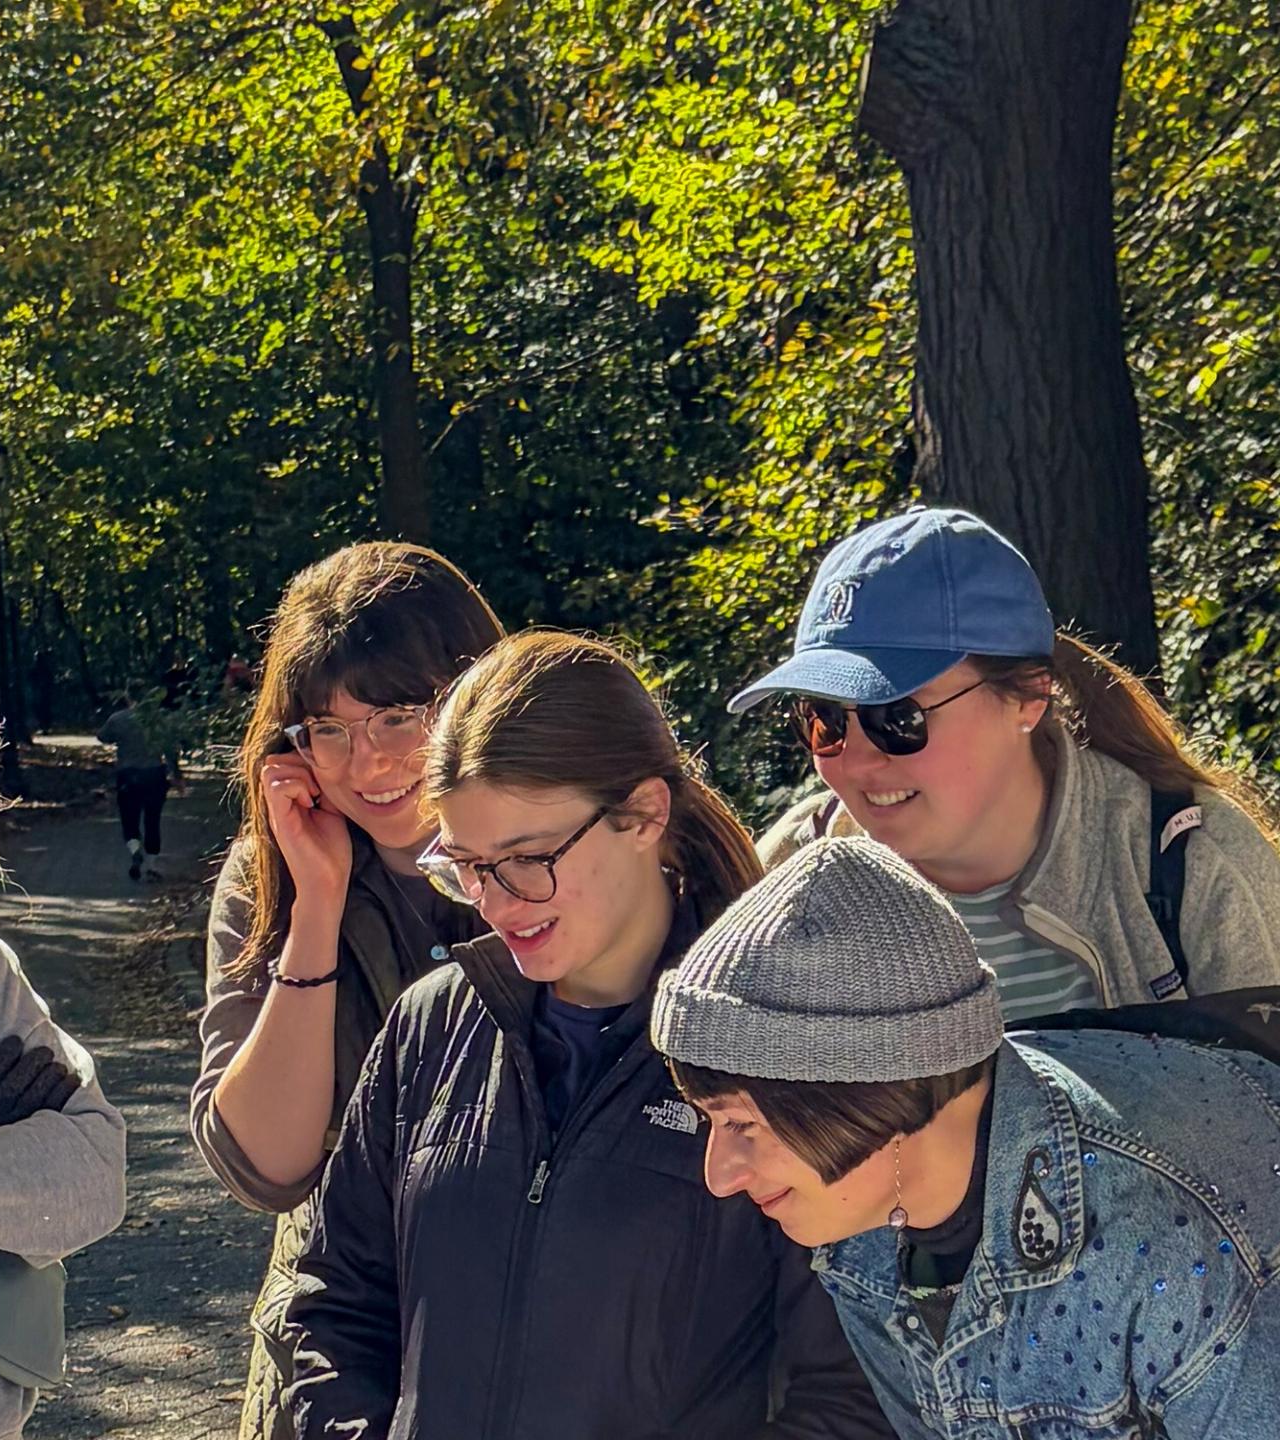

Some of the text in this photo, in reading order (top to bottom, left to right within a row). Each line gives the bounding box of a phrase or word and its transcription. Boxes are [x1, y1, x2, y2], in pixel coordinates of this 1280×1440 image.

[663, 1100, 685, 1112] THE
[643, 1105, 682, 1120] NORTH
[650, 1117, 678, 1129] FACE
